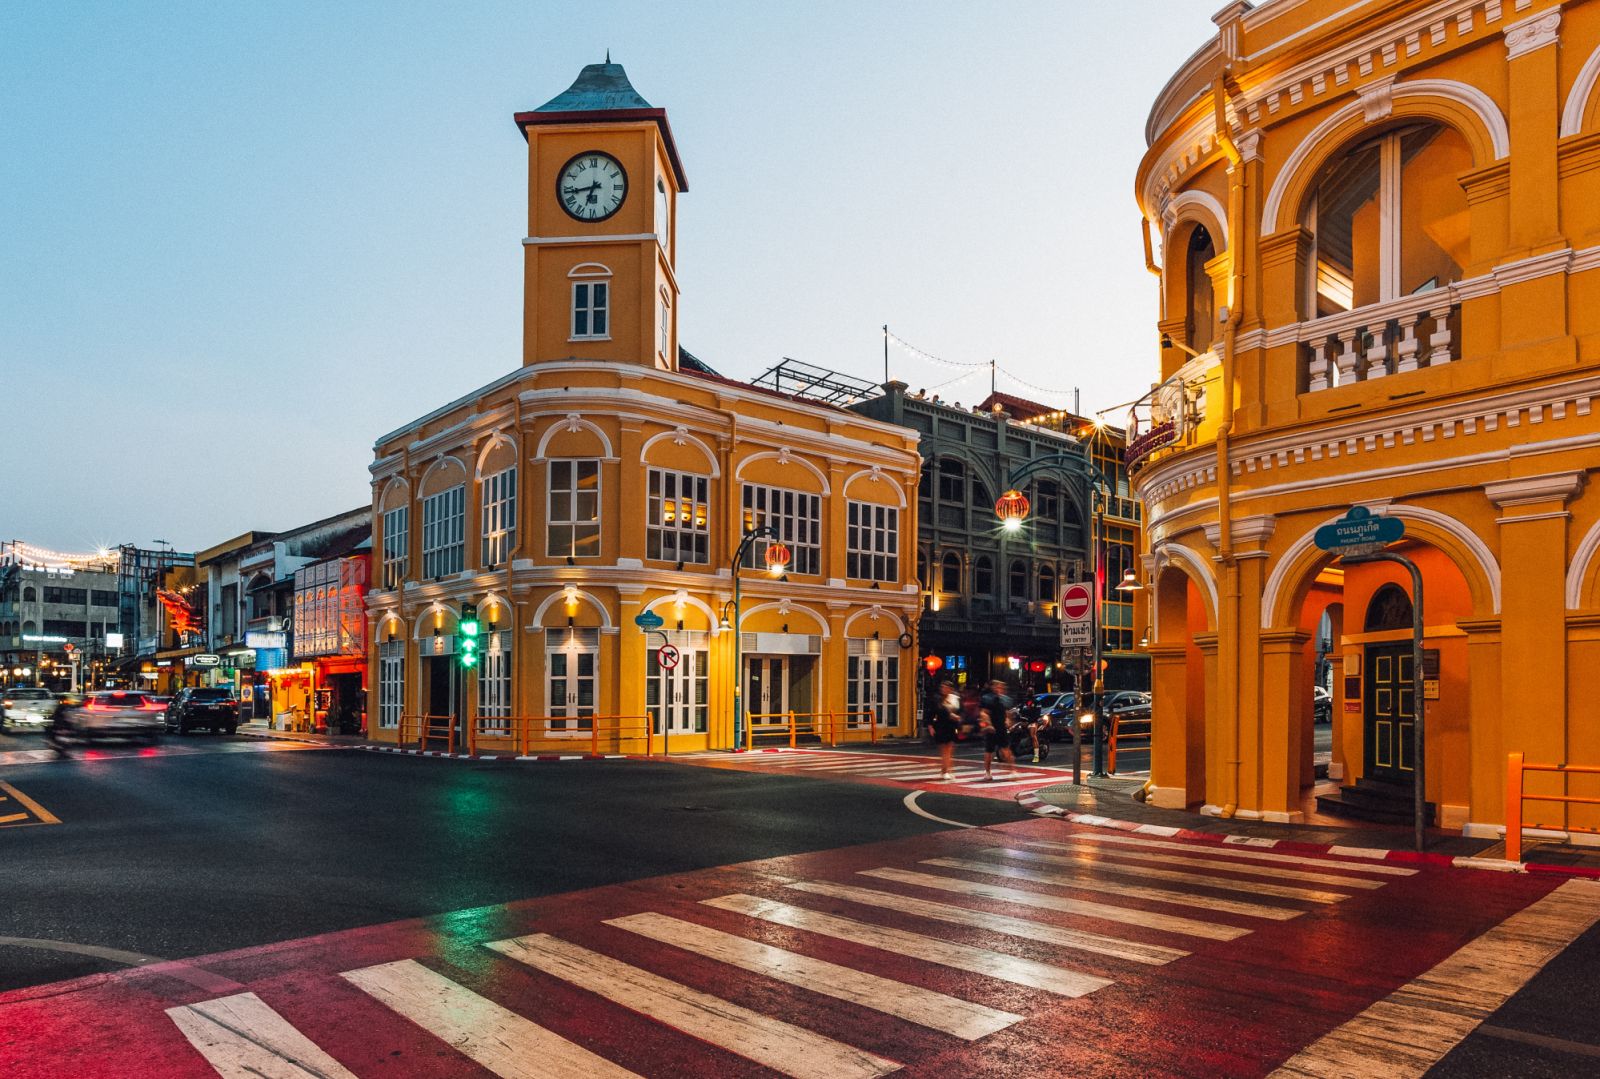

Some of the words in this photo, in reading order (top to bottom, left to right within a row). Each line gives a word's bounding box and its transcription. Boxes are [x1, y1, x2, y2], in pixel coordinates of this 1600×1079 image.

[576, 161, 586, 172] XI
[589, 158, 598, 168] XII
[567, 172, 577, 181] X
[1336, 521, 1379, 537] ถนนภูเก็ต
[1063, 624, 1089, 636] ห้ามเข้า
